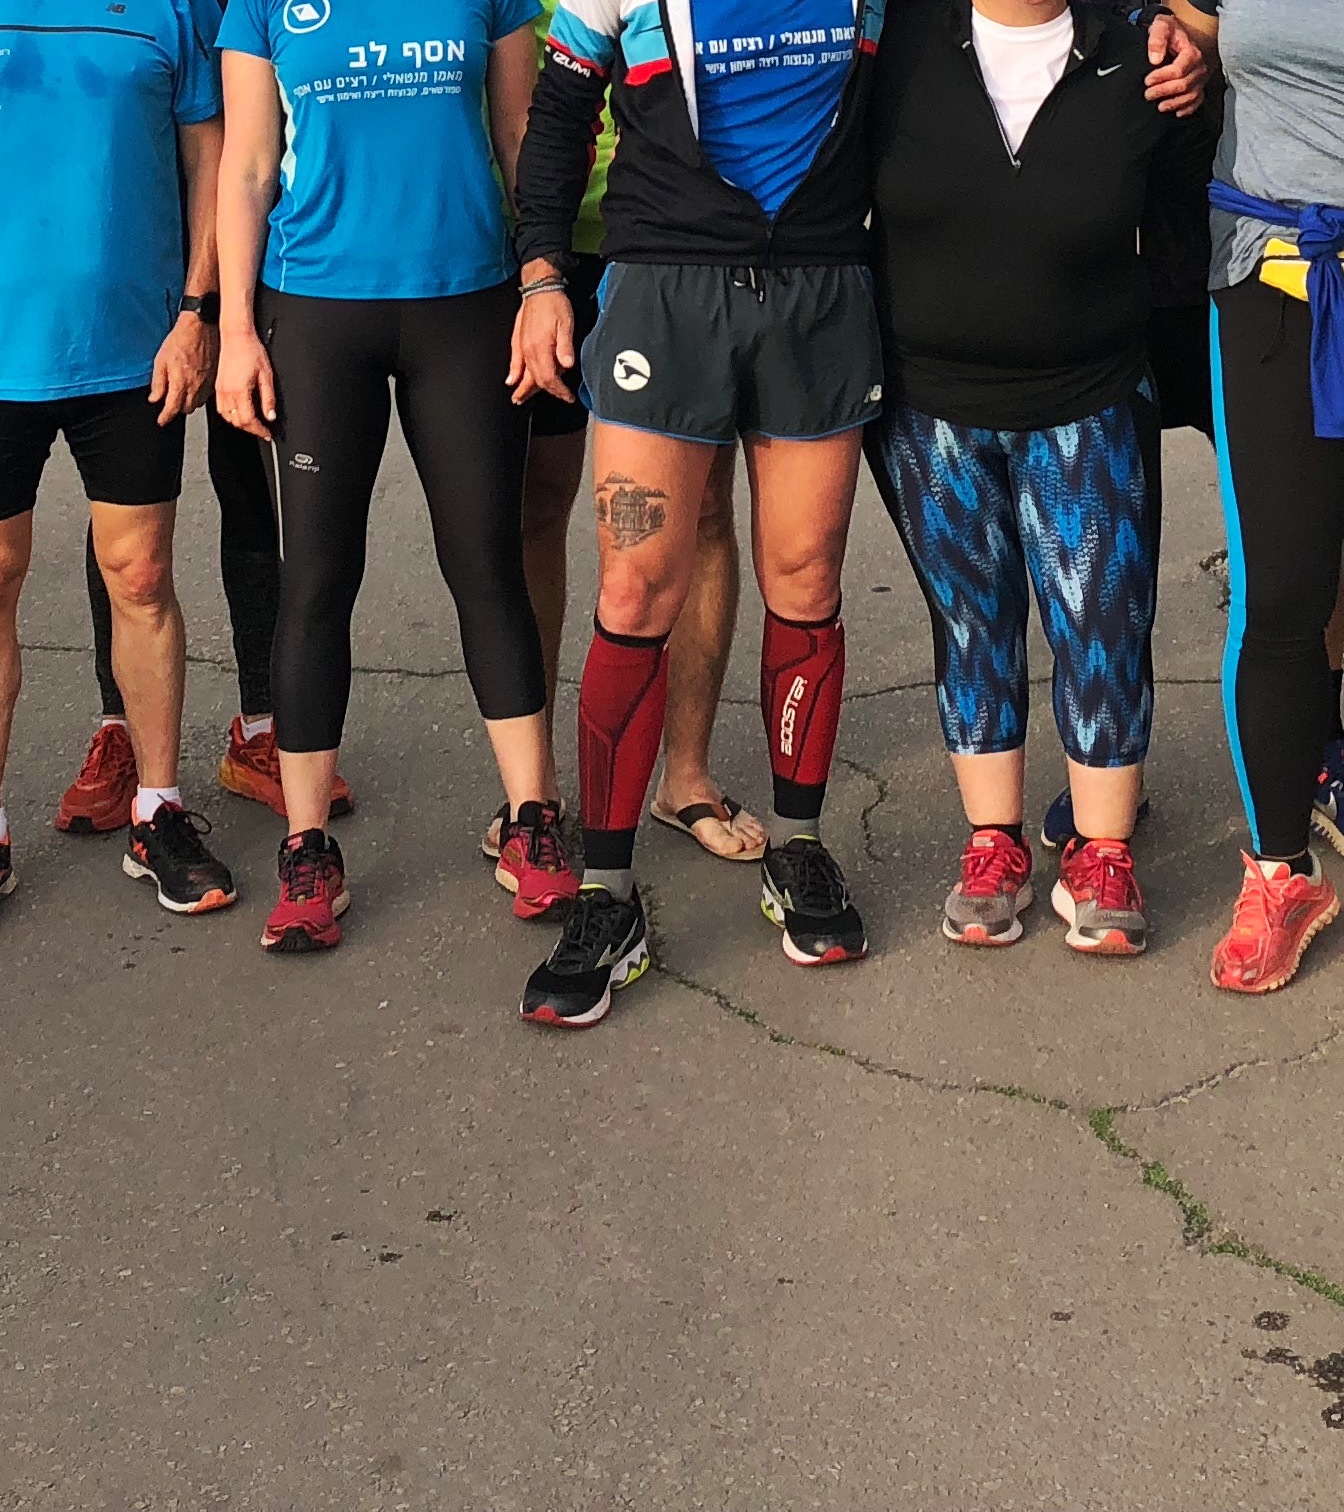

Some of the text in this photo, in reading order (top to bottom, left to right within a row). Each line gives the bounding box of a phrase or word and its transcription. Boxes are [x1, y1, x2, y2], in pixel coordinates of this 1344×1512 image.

[732, 35, 763, 52] רצים
[780, 28, 826, 45] מנטאלי
[348, 40, 465, 69] אסף לב
[709, 39, 727, 55] עם
[313, 79, 332, 91] עם
[336, 75, 367, 88] רצים
[382, 72, 428, 85] מנטאלי
[433, 70, 463, 84] מאמן
[780, 675, 808, 757] BOOSTER
